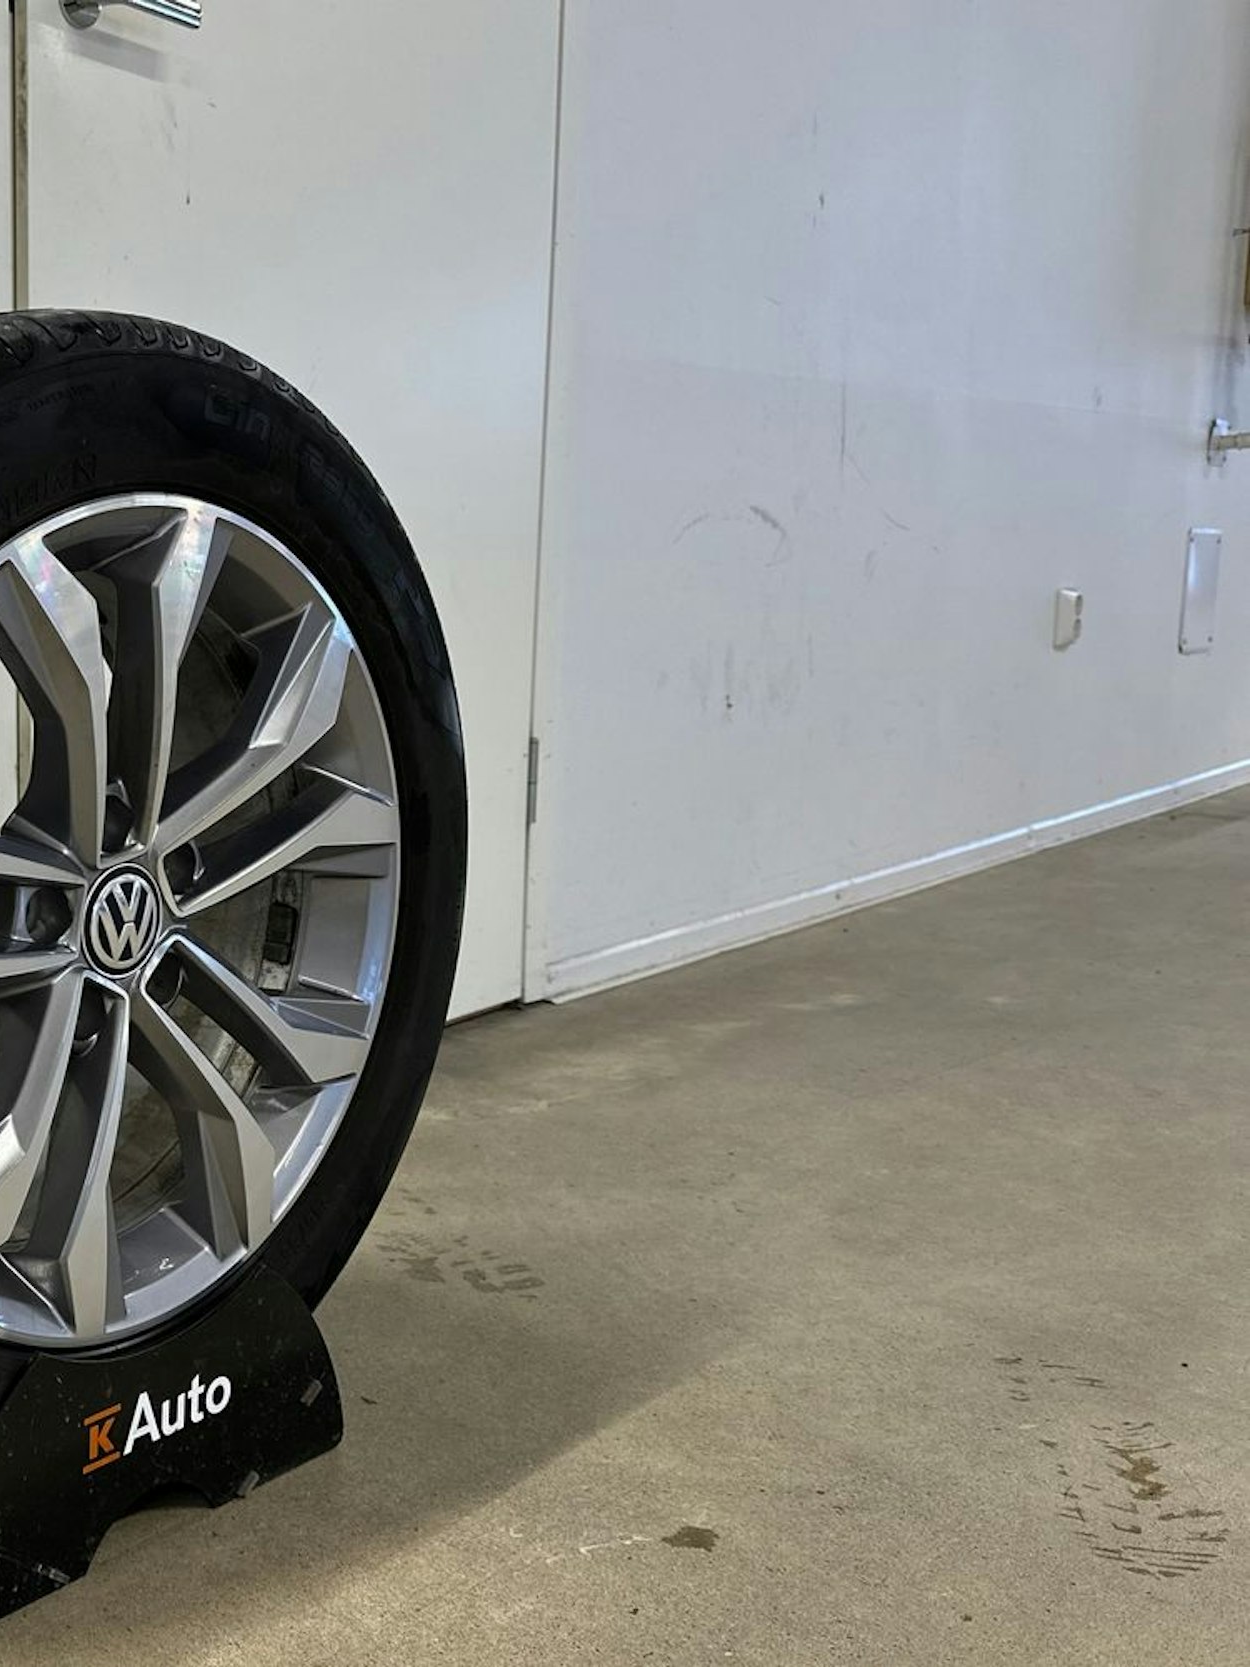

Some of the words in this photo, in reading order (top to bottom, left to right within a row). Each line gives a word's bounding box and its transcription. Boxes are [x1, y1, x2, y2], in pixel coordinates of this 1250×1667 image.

[90, 873, 158, 969] VW
[83, 1403, 121, 1474] K
[123, 1374, 231, 1456] Auto
